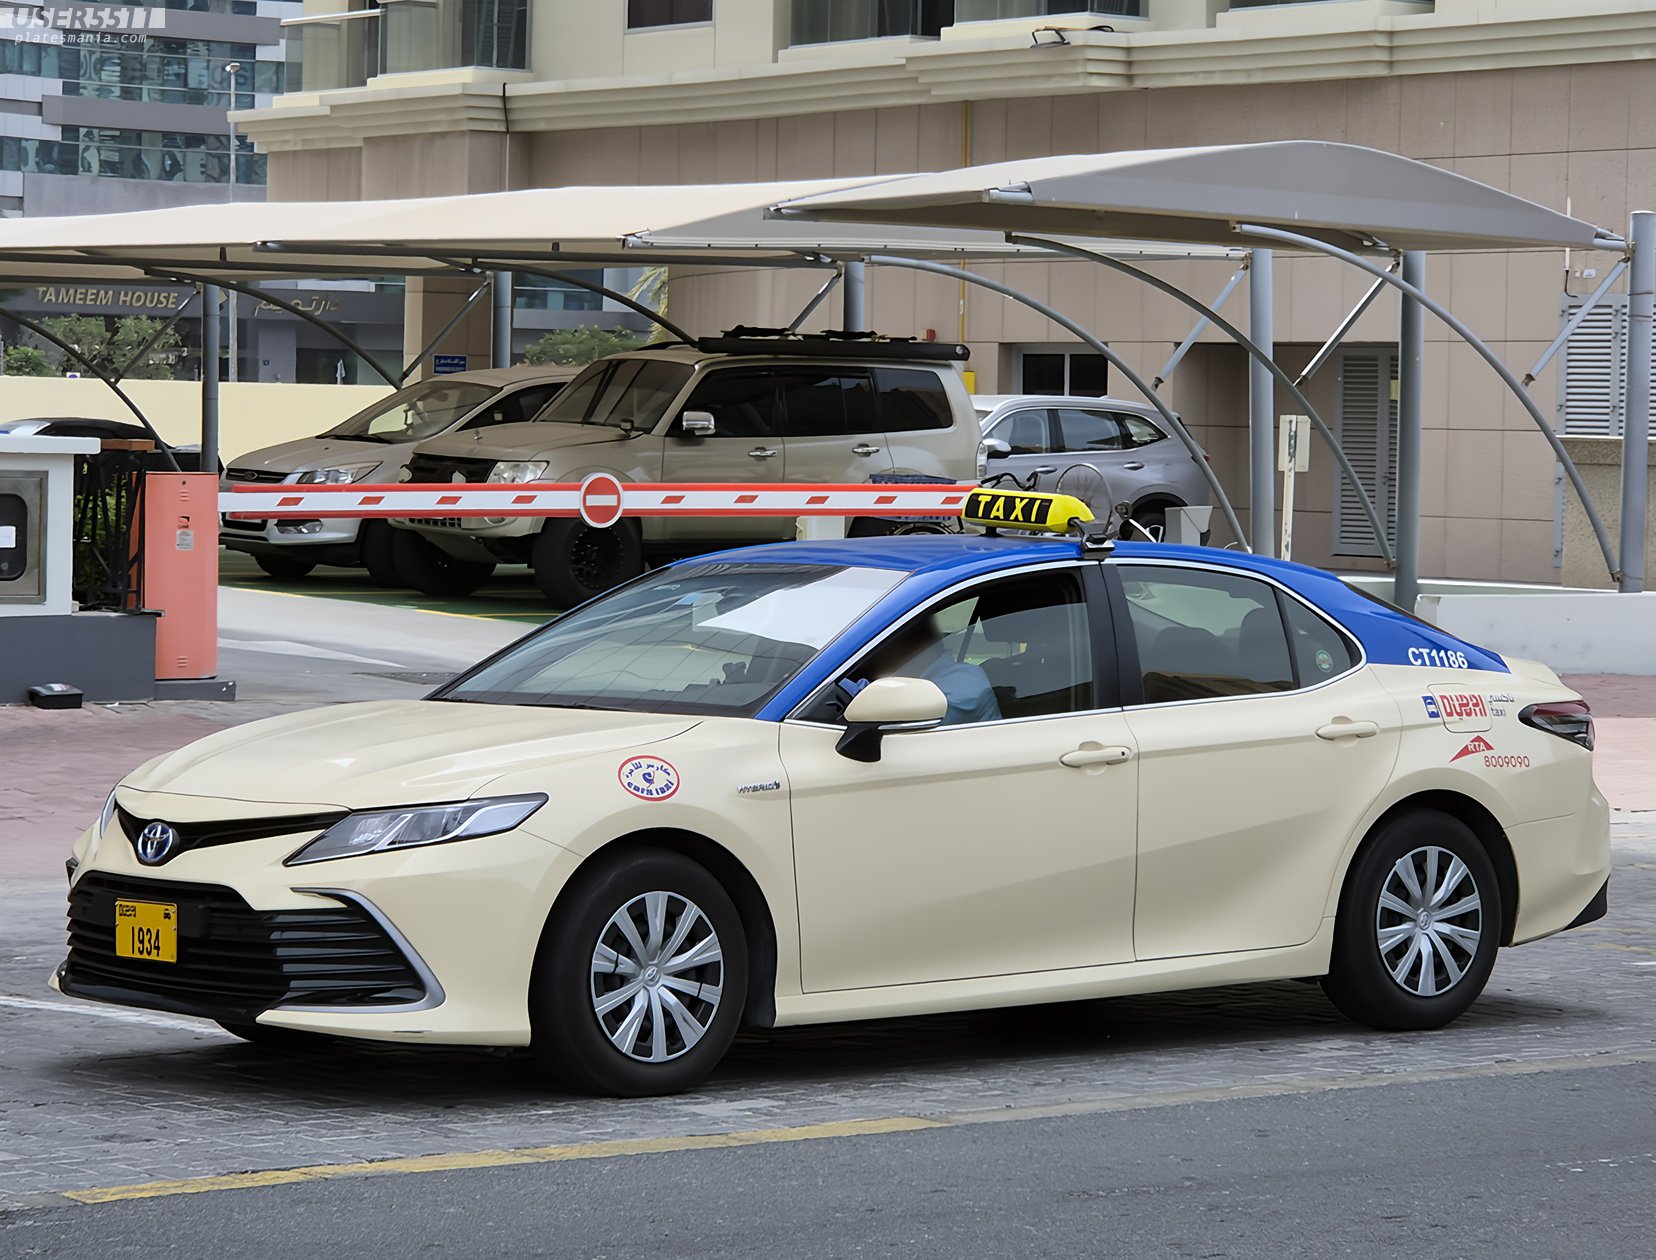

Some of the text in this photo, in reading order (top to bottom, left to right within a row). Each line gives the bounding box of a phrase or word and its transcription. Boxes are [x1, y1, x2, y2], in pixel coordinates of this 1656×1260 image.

[36, 287, 179, 308] TAMEEM HOUSE
[977, 495, 1041, 522] TAXI
[1407, 647, 1468, 669] CT1186
[1490, 706, 1507, 717] taxi
[1467, 741, 1487, 752] RTA
[1483, 755, 1531, 768] 8009090
[131, 925, 161, 958] 1934
